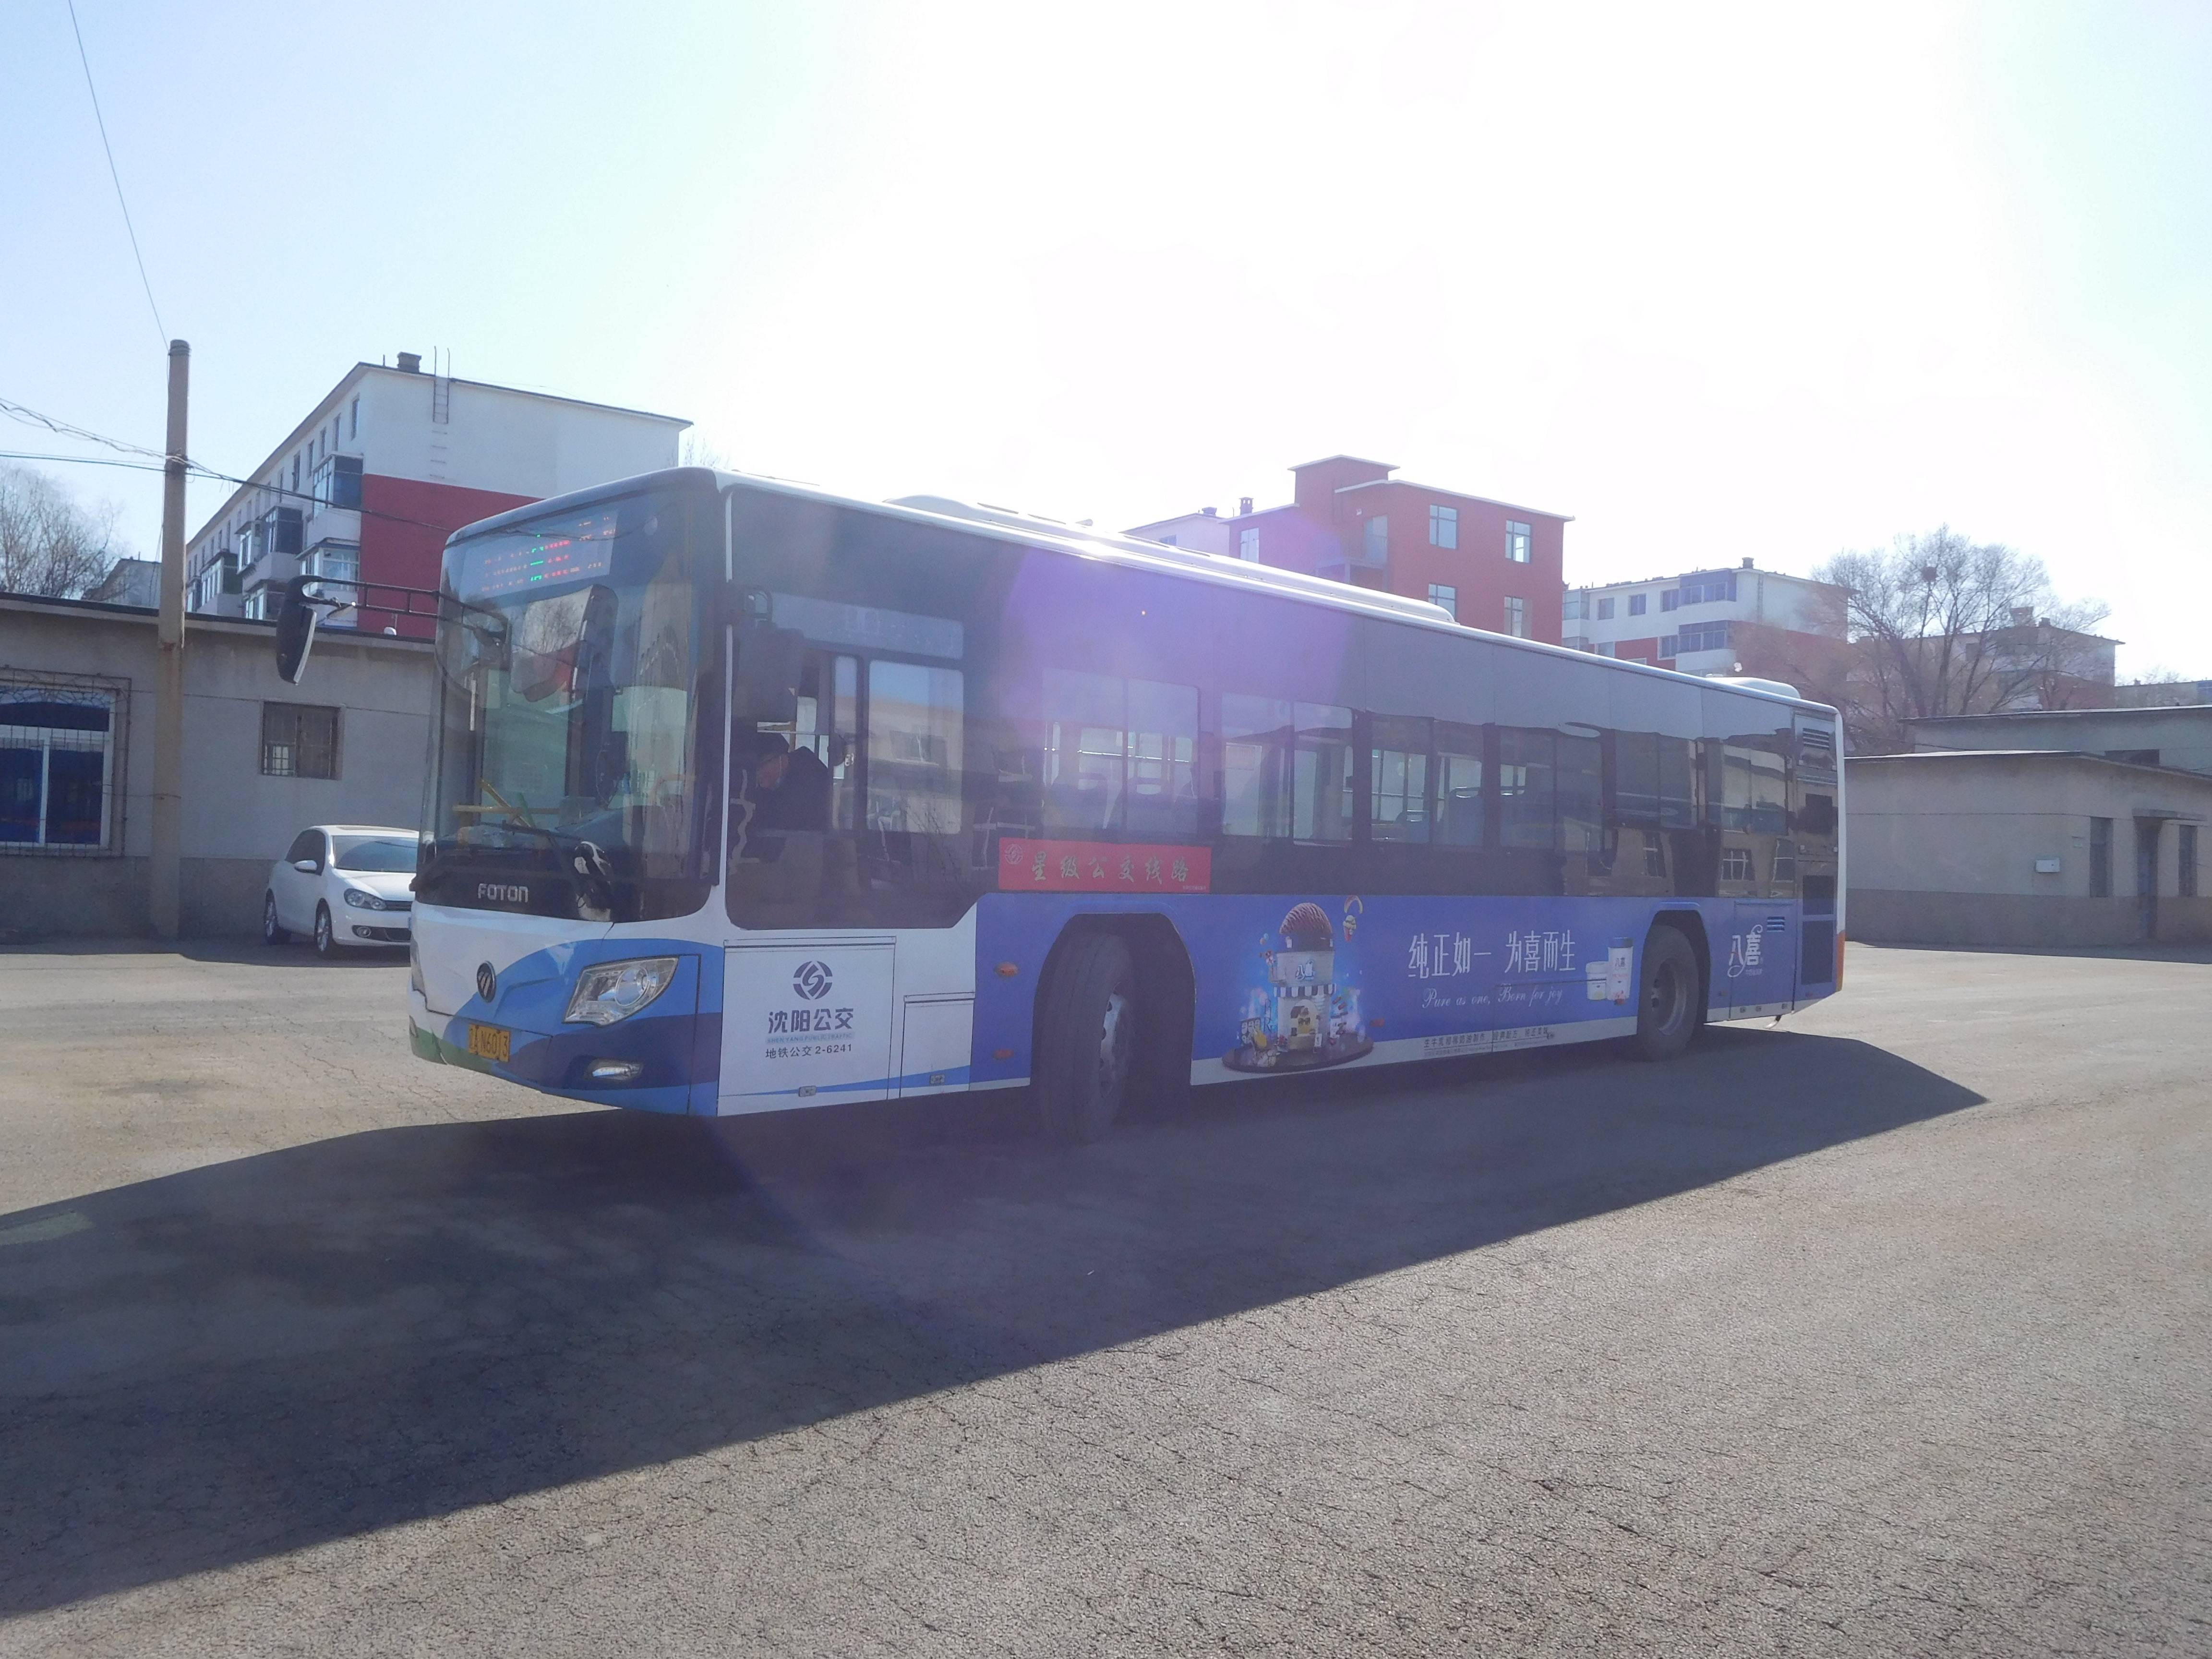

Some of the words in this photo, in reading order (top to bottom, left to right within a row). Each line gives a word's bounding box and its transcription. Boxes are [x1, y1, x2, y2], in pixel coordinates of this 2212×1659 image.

[478, 883, 528, 903] FOTON
[1408, 932, 1492, 979] 纯正如一
[1504, 929, 1576, 974] 为喜而生
[1422, 987, 1452, 1009] Pure
[1455, 996, 1466, 1005] as
[1498, 983, 1527, 1003] Born
[1528, 985, 1545, 1007] for
[768, 1007, 854, 1034] 沈阳公交
